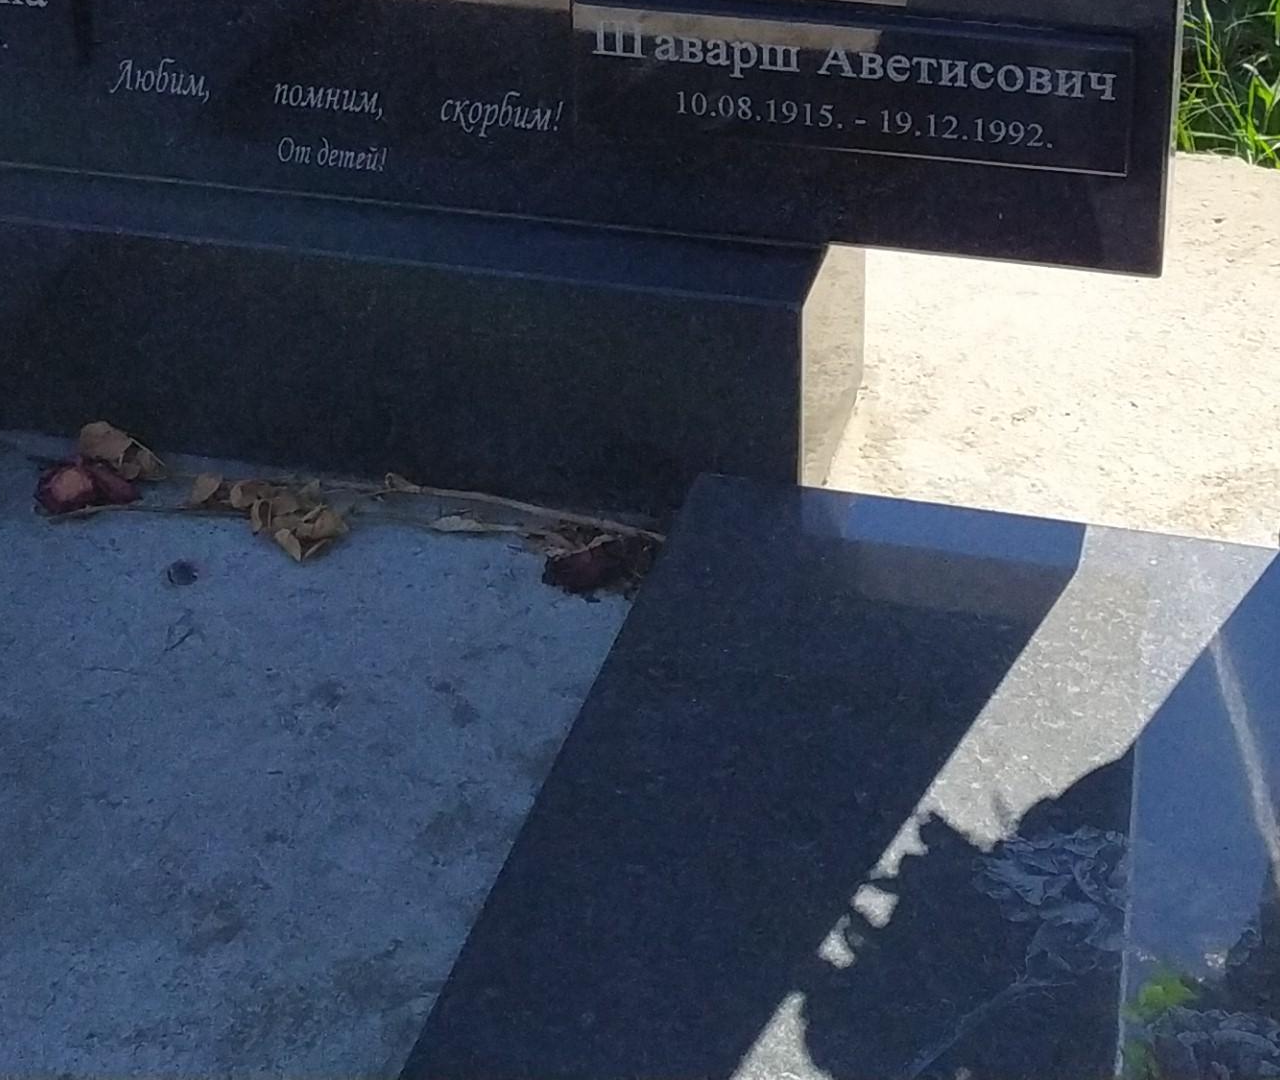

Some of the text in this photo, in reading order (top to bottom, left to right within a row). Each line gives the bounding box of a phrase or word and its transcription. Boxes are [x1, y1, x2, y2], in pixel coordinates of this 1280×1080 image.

[590, 21, 1118, 102] Шаварш Аветисович
[110, 57, 564, 138] Любим, помним, скорбим!
[675, 90, 844, 129] 10.08.1915.
[880, 110, 1054, 149] 19.12.1992.
[277, 136, 388, 173] От детей!
